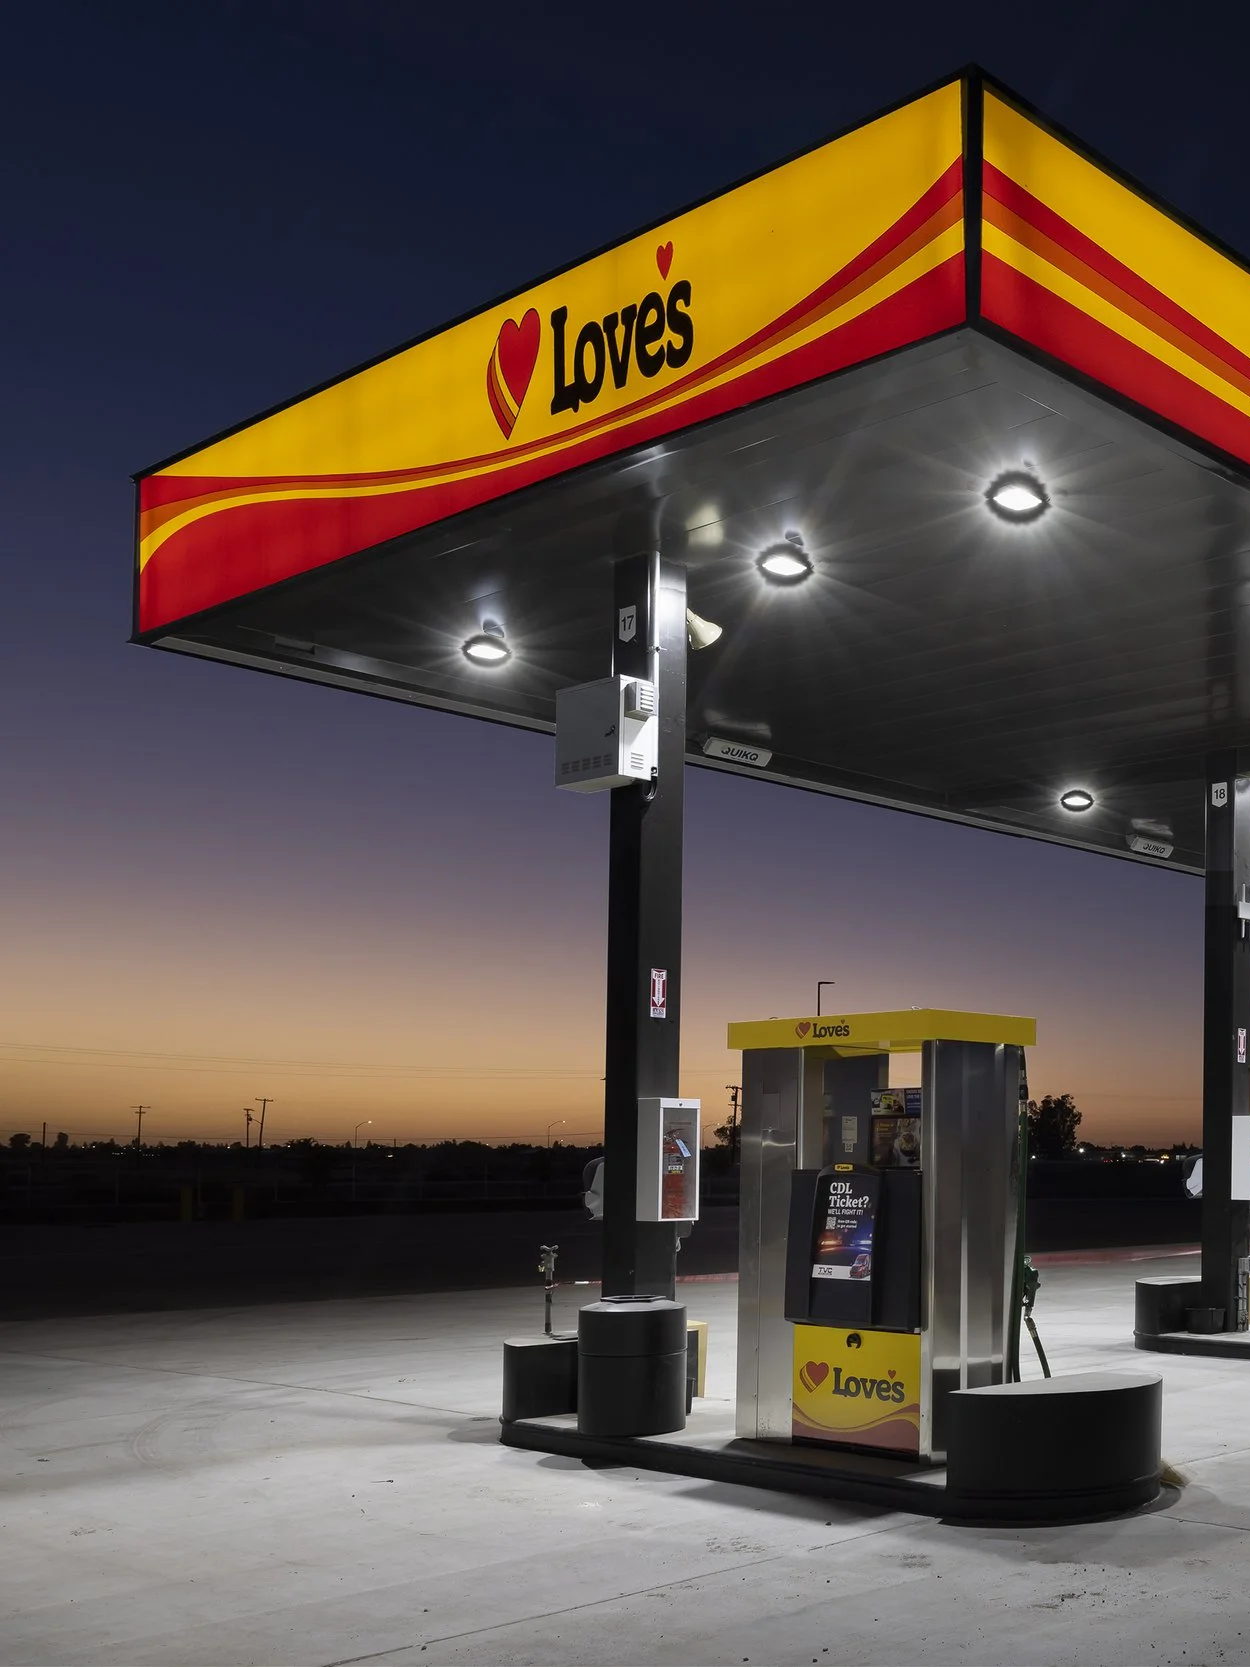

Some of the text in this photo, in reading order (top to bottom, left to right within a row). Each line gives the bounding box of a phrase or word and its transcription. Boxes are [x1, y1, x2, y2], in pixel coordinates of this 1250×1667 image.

[621, 614, 635, 632] 17
[721, 745, 759, 762] QUIKQ
[1214, 788, 1226, 800] 18
[830, 1182, 853, 1194] CDL
[829, 1195, 869, 1208] Ticket?
